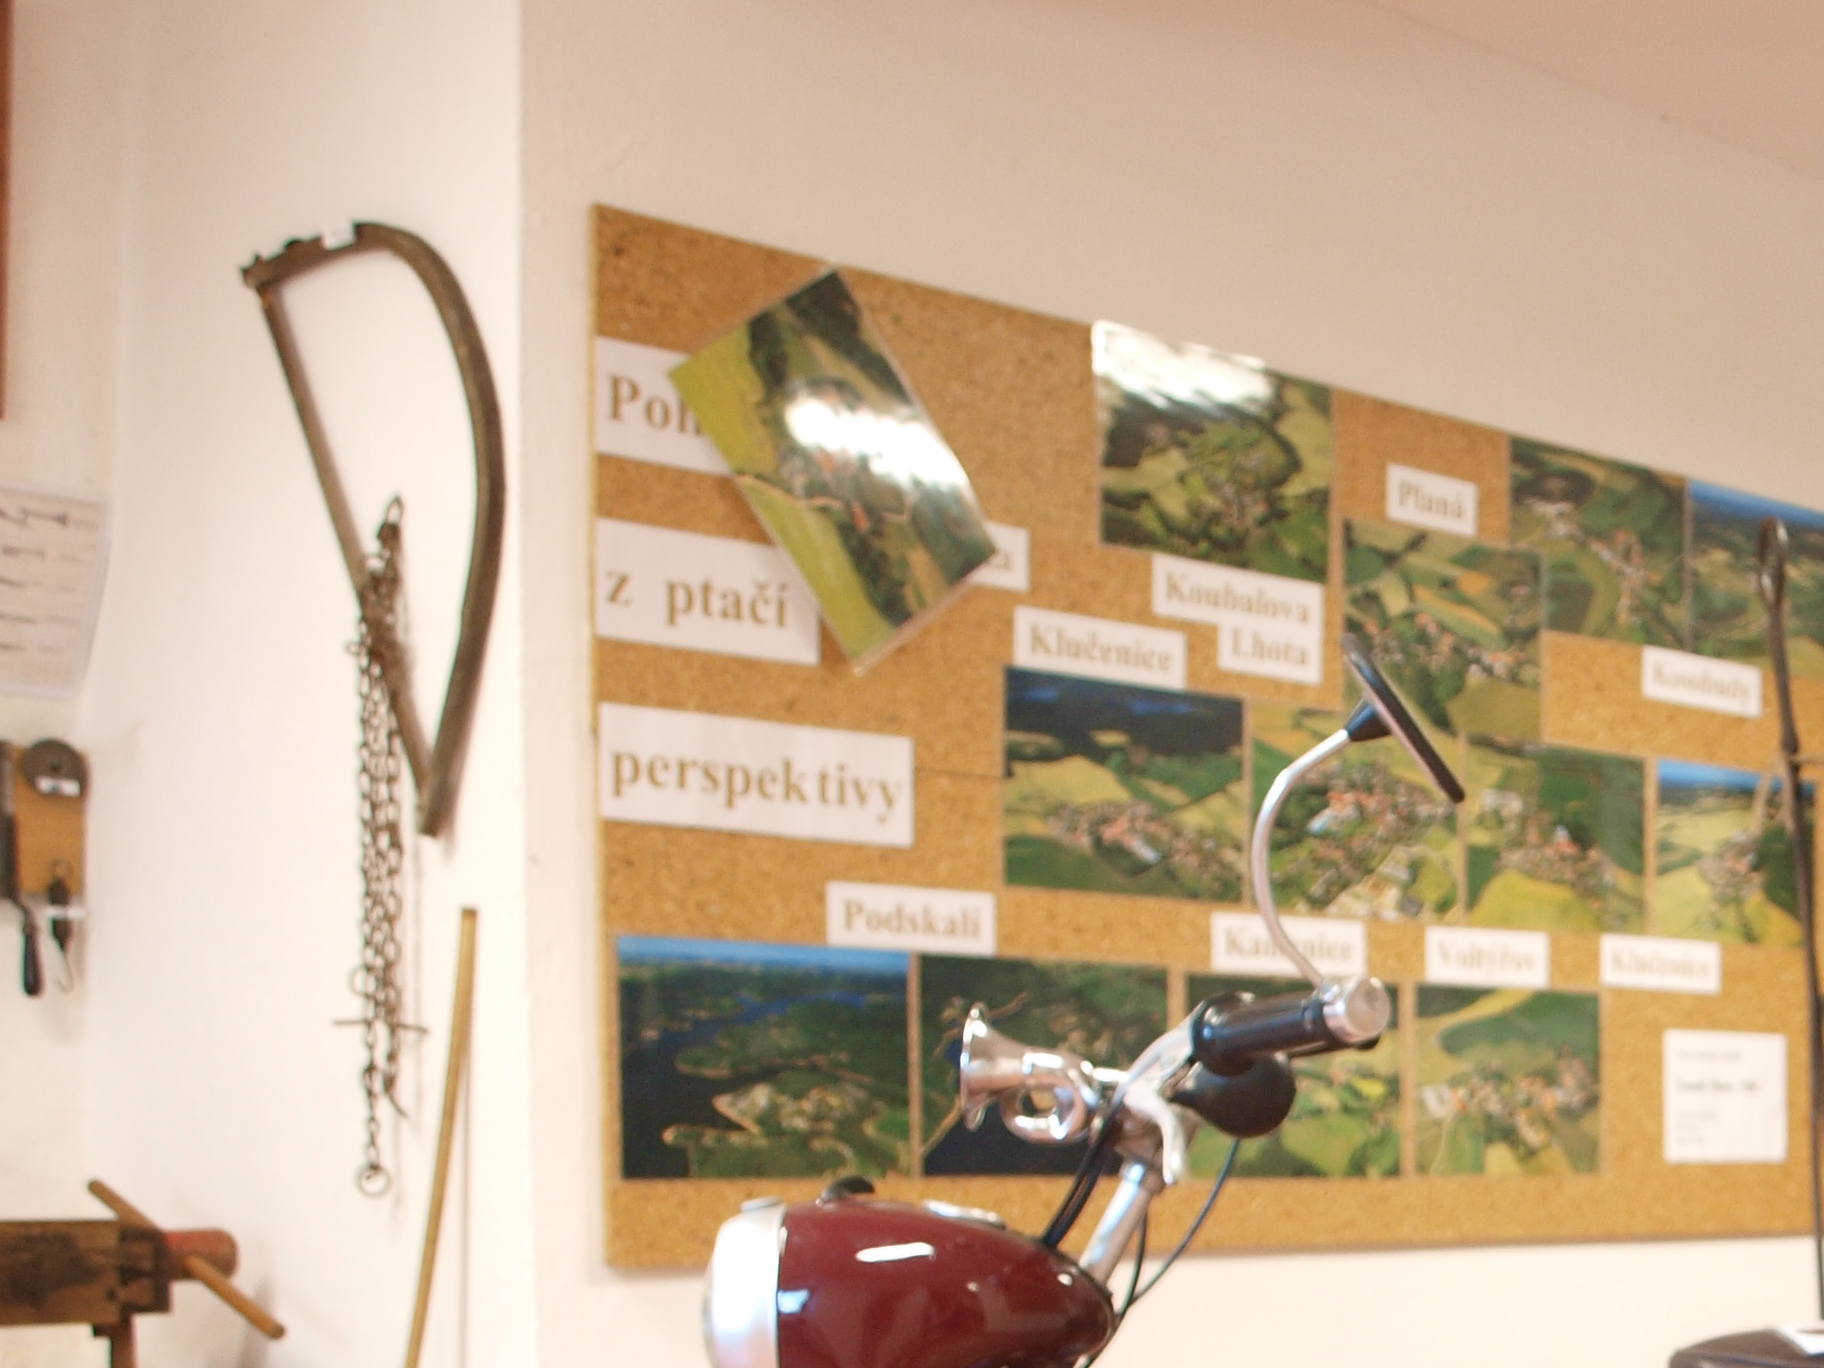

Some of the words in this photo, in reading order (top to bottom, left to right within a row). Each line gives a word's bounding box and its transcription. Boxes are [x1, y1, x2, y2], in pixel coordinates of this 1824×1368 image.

[606, 572, 632, 606] z
[666, 577, 787, 626] ptačí
[1164, 574, 1311, 624] Koubalova
[1030, 623, 1173, 672] Klučenice
[1230, 626, 1308, 667] Lhota
[612, 750, 898, 822] perspektivy
[843, 898, 982, 940] Podskalí
